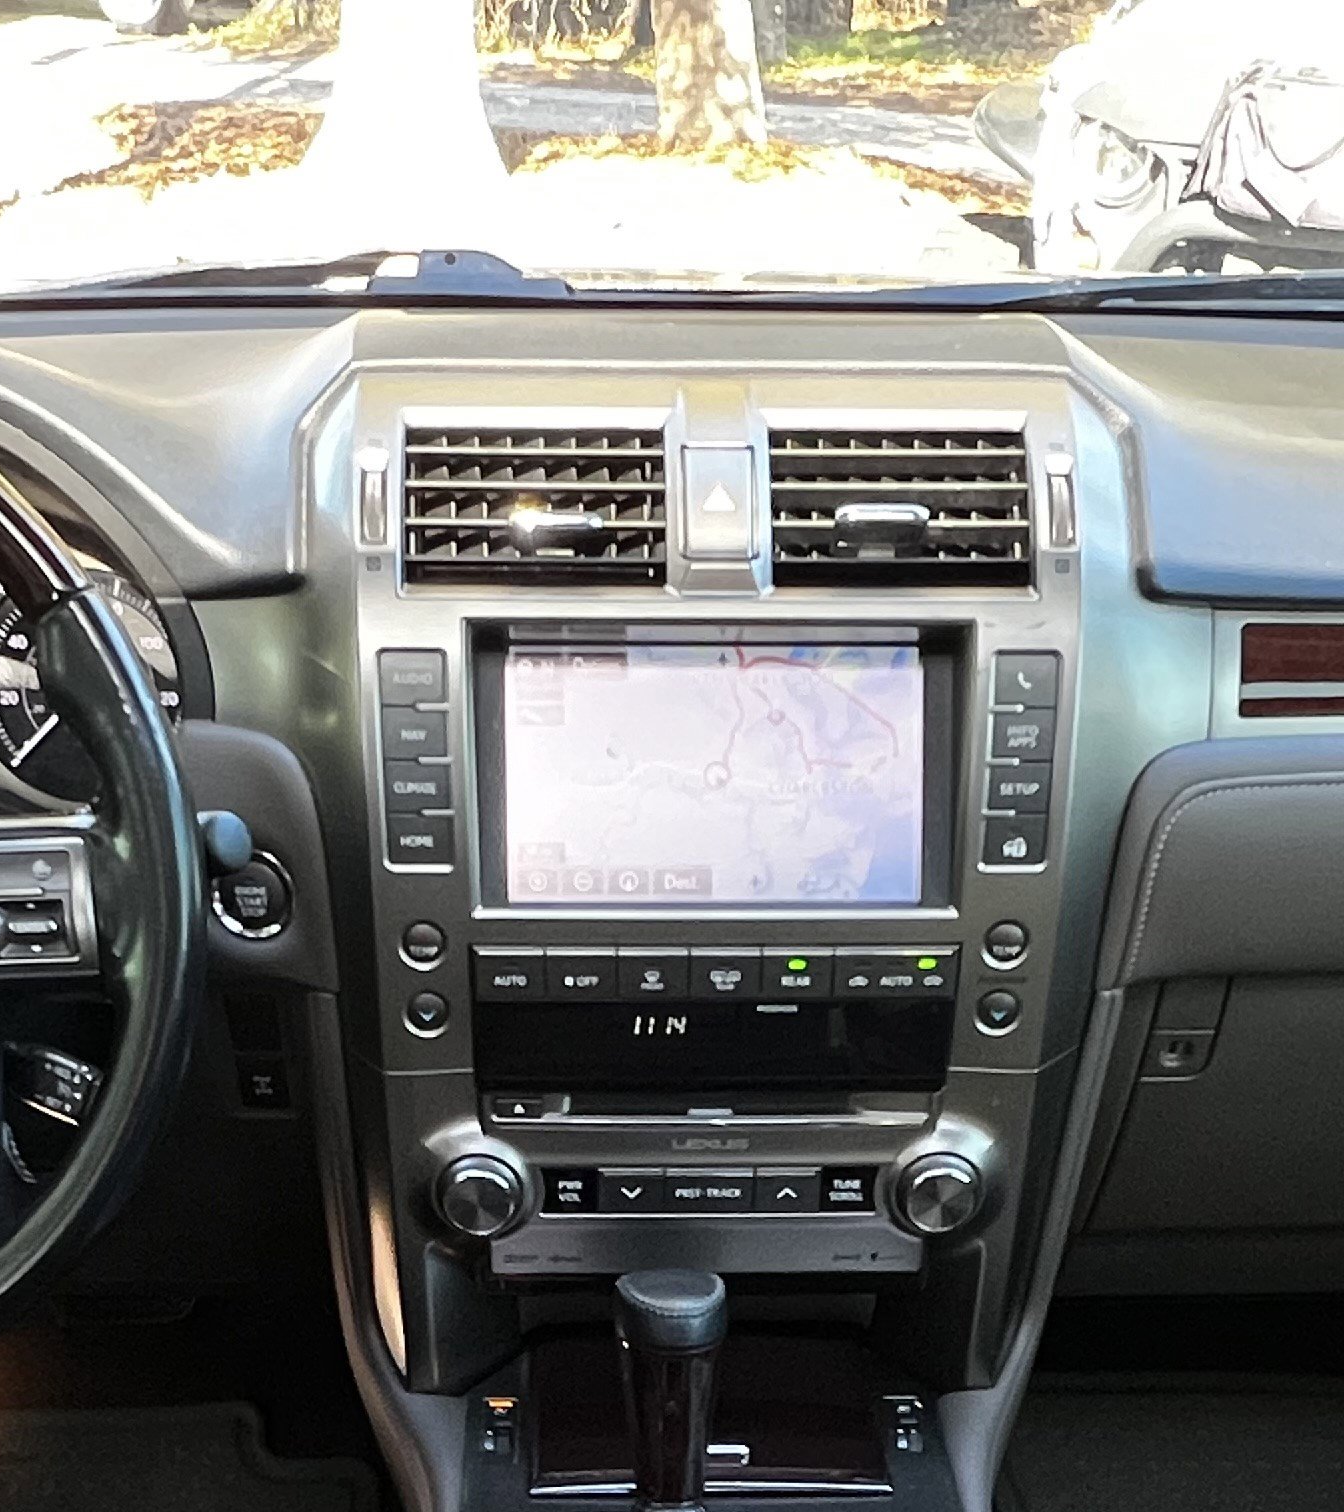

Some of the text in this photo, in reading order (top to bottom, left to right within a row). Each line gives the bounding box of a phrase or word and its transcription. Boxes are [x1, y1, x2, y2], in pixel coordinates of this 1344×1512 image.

[393, 673, 433, 685] AUDIO
[401, 729, 427, 741] NAV
[1000, 782, 1040, 796] SETUP
[400, 835, 434, 849] HOME
[493, 975, 528, 987] AUTO
[576, 975, 600, 987] OFF
[879, 975, 914, 987] AUTO
[671, 1138, 750, 1151] LEXUS
